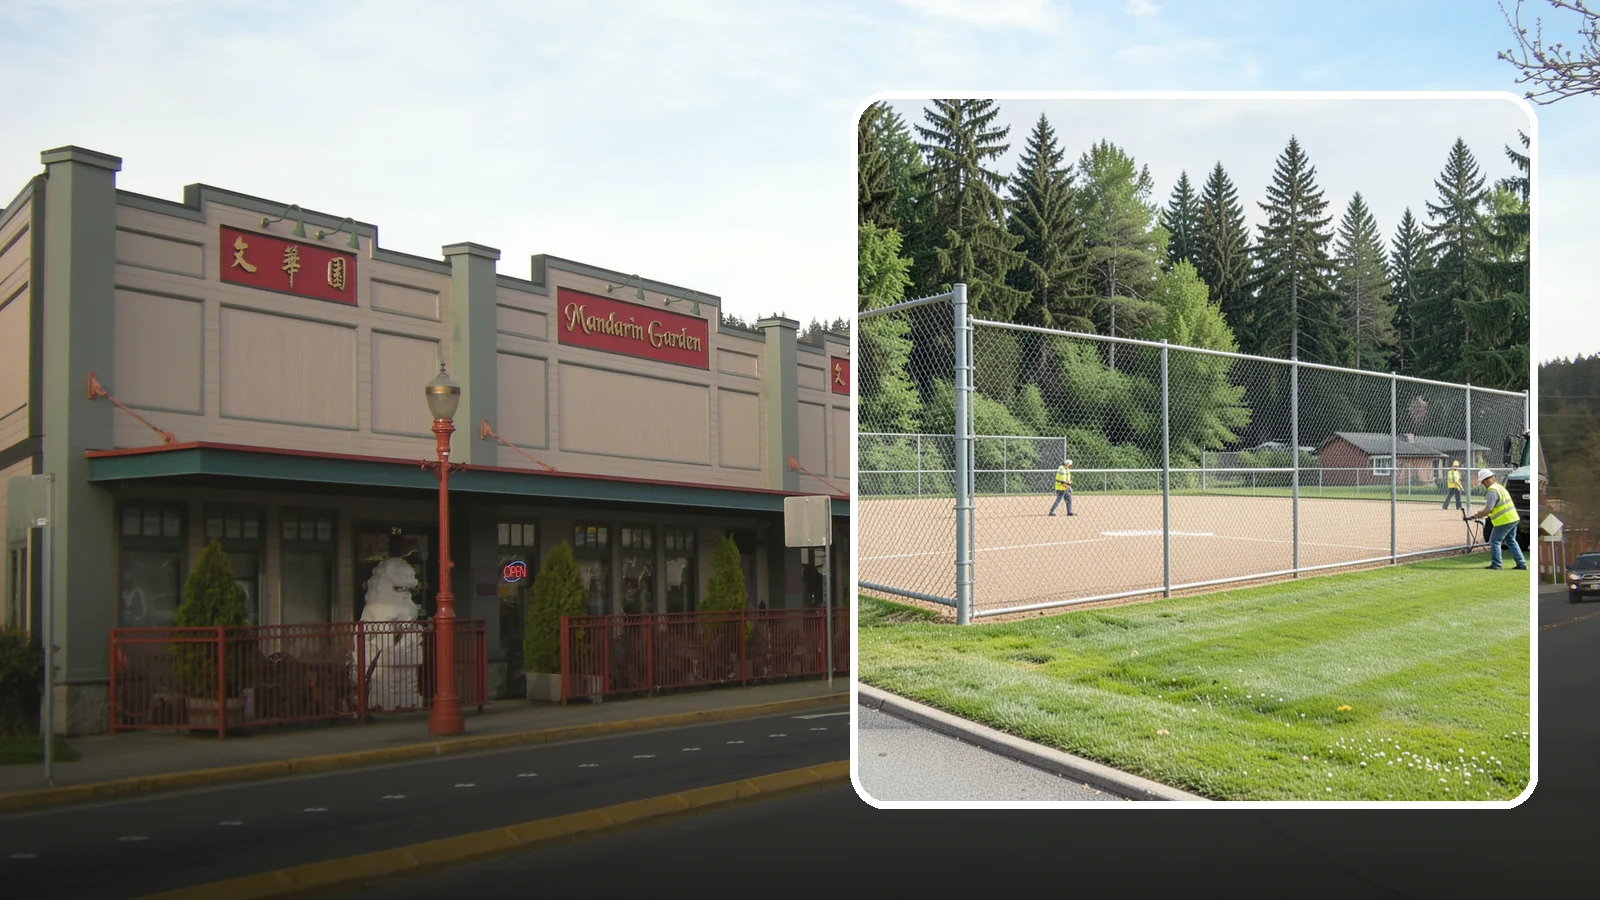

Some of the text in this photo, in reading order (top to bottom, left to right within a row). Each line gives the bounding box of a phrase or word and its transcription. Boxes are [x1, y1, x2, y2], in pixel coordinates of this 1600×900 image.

[231, 236, 346, 290] 文華園
[565, 302, 701, 351] Mandarin Garden
[835, 363, 846, 386] 文
[503, 565, 527, 578] OPEN
